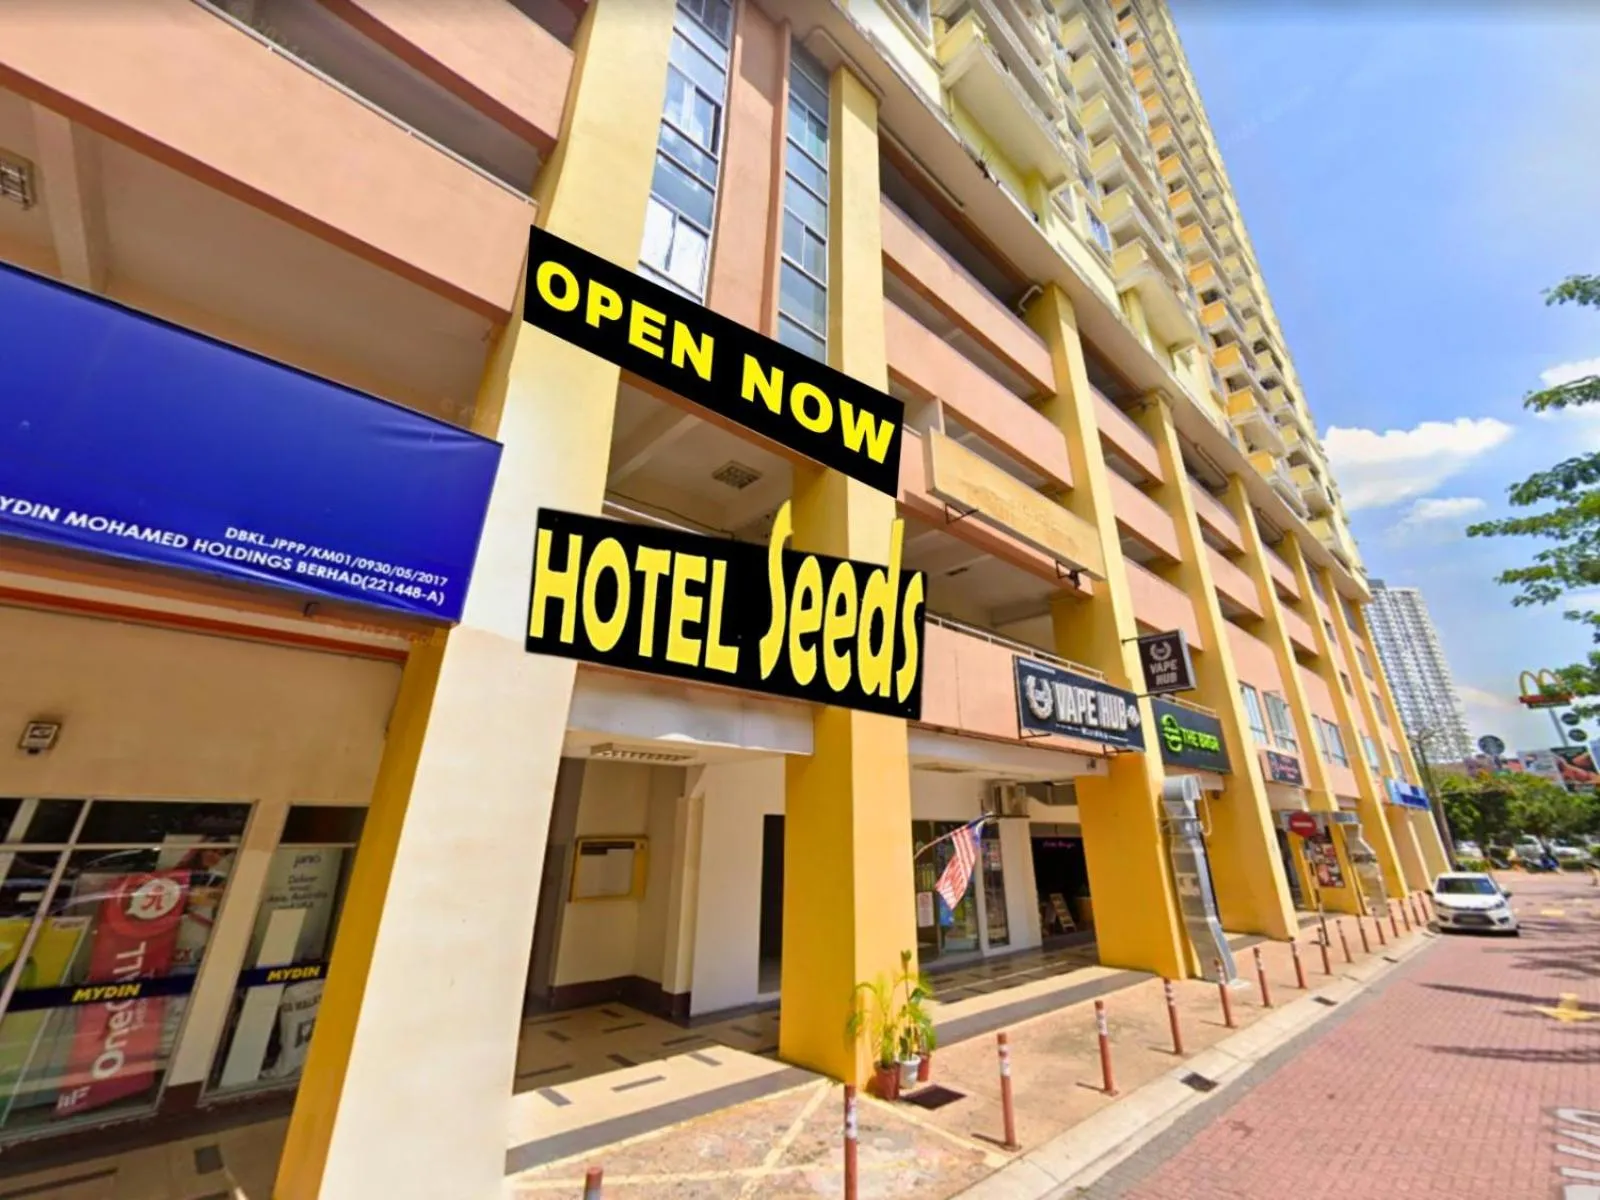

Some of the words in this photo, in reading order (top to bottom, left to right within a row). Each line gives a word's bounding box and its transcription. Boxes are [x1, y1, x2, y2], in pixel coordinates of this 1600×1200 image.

[64, 511, 188, 548] MOHAMED
[193, 538, 292, 570] HOLDINGS
[529, 528, 739, 673] HOTEL
[759, 500, 924, 703] Seeds
[1150, 659, 1178, 674] VAPE
[1051, 681, 1098, 726] VAPE
[1097, 691, 1127, 731] HUB
[266, 966, 321, 982] MYDIN
[72, 983, 142, 1004] MYDIN
